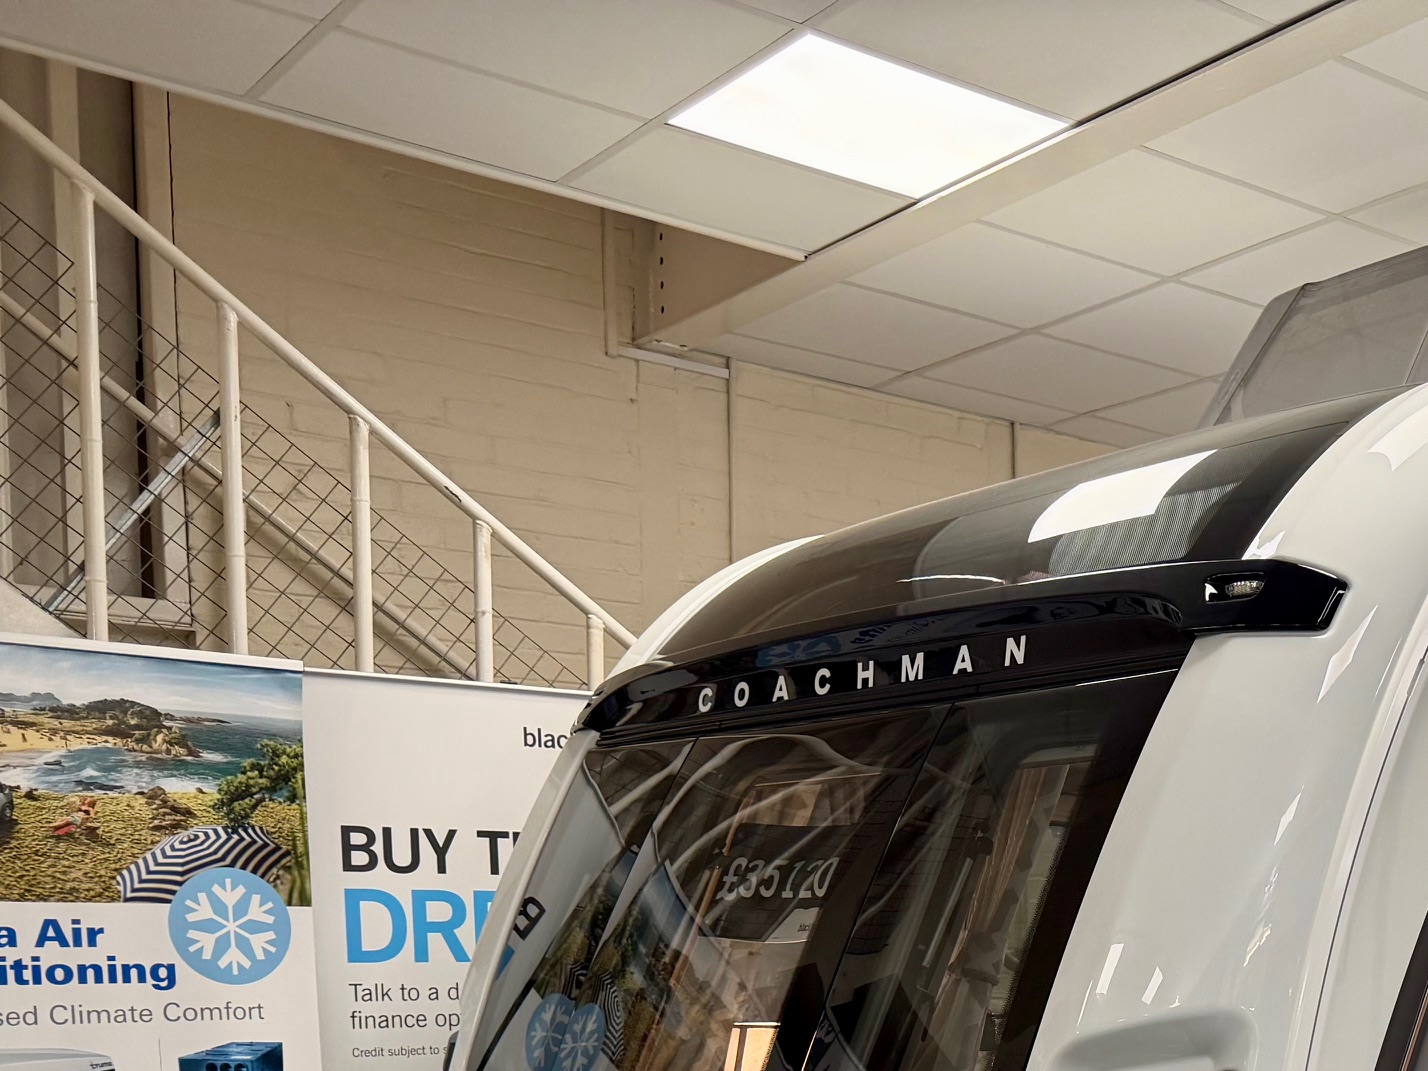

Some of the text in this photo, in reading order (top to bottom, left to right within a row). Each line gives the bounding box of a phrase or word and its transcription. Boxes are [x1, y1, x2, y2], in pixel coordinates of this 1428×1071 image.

[698, 635, 1026, 713] COACHMAN
[340, 825, 522, 877] BUY T
[715, 857, 839, 901] £35120
[35, 919, 104, 948] Air
[349, 983, 393, 1003] Talk
[400, 983, 420, 1001] to
[428, 986, 439, 1001] a
[50, 1004, 153, 1026] Climate
[163, 1001, 265, 1023] Comfort
[350, 1010, 462, 1031] finance op
[352, 1046, 385, 1058] Credit
[388, 1045, 427, 1059] subject
[430, 1046, 440, 1056] to
